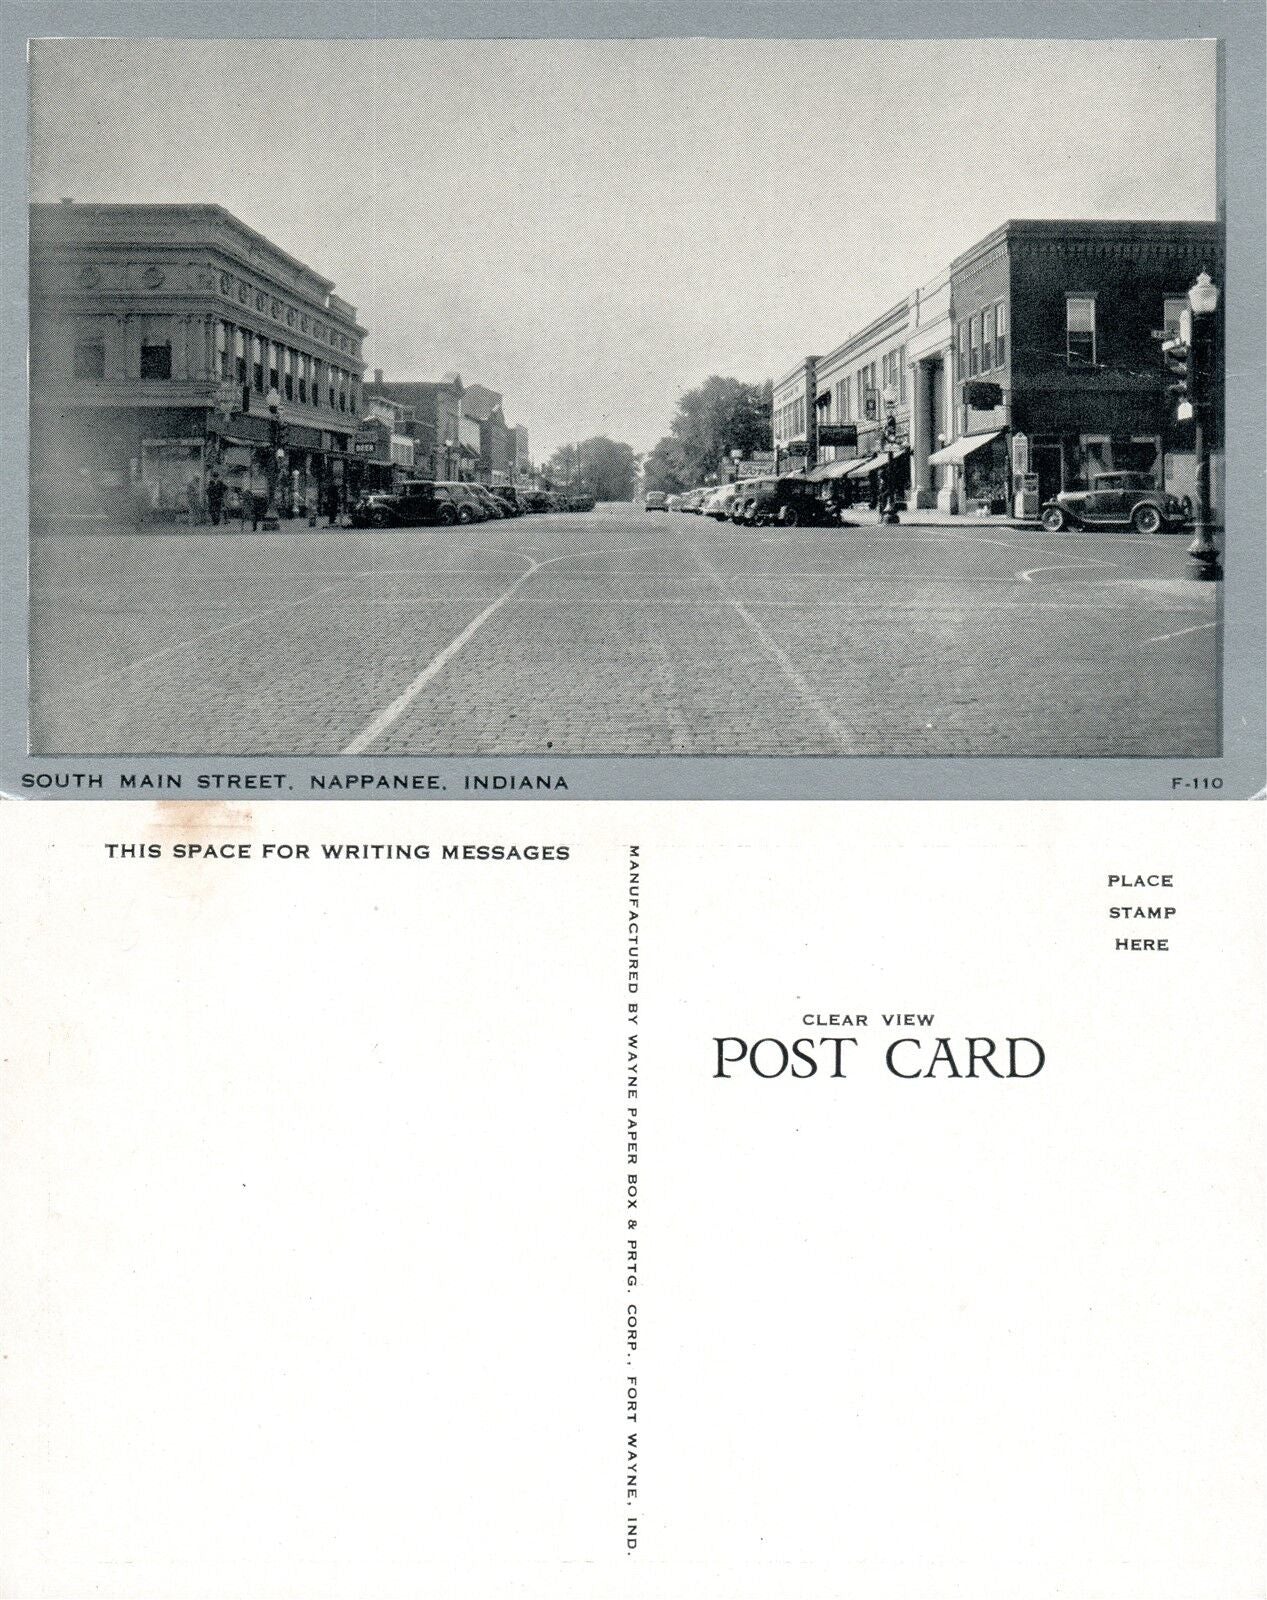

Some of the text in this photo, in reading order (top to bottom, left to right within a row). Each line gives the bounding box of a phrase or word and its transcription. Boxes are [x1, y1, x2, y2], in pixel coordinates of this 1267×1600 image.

[21, 773, 103, 789] SOUTH
[120, 774, 182, 789] MAIN
[464, 775, 569, 790] INDIANA
[1172, 777, 1224, 789] F-110
[105, 843, 570, 861] THIS SPACE FOR WRITING MESSAGES
[1108, 874, 1173, 888] PLACE
[1109, 906, 1176, 919] STAMP
[1115, 938, 1169, 951] HERE
[802, 1013, 935, 1026] CLEAR VIEW
[713, 1037, 1046, 1079] POST CARD
[627, 845, 640, 1556] MANUFACTURED BY WAYNE PAPER BOX & PRTG. CORP., FORT WAYNE, IND.
